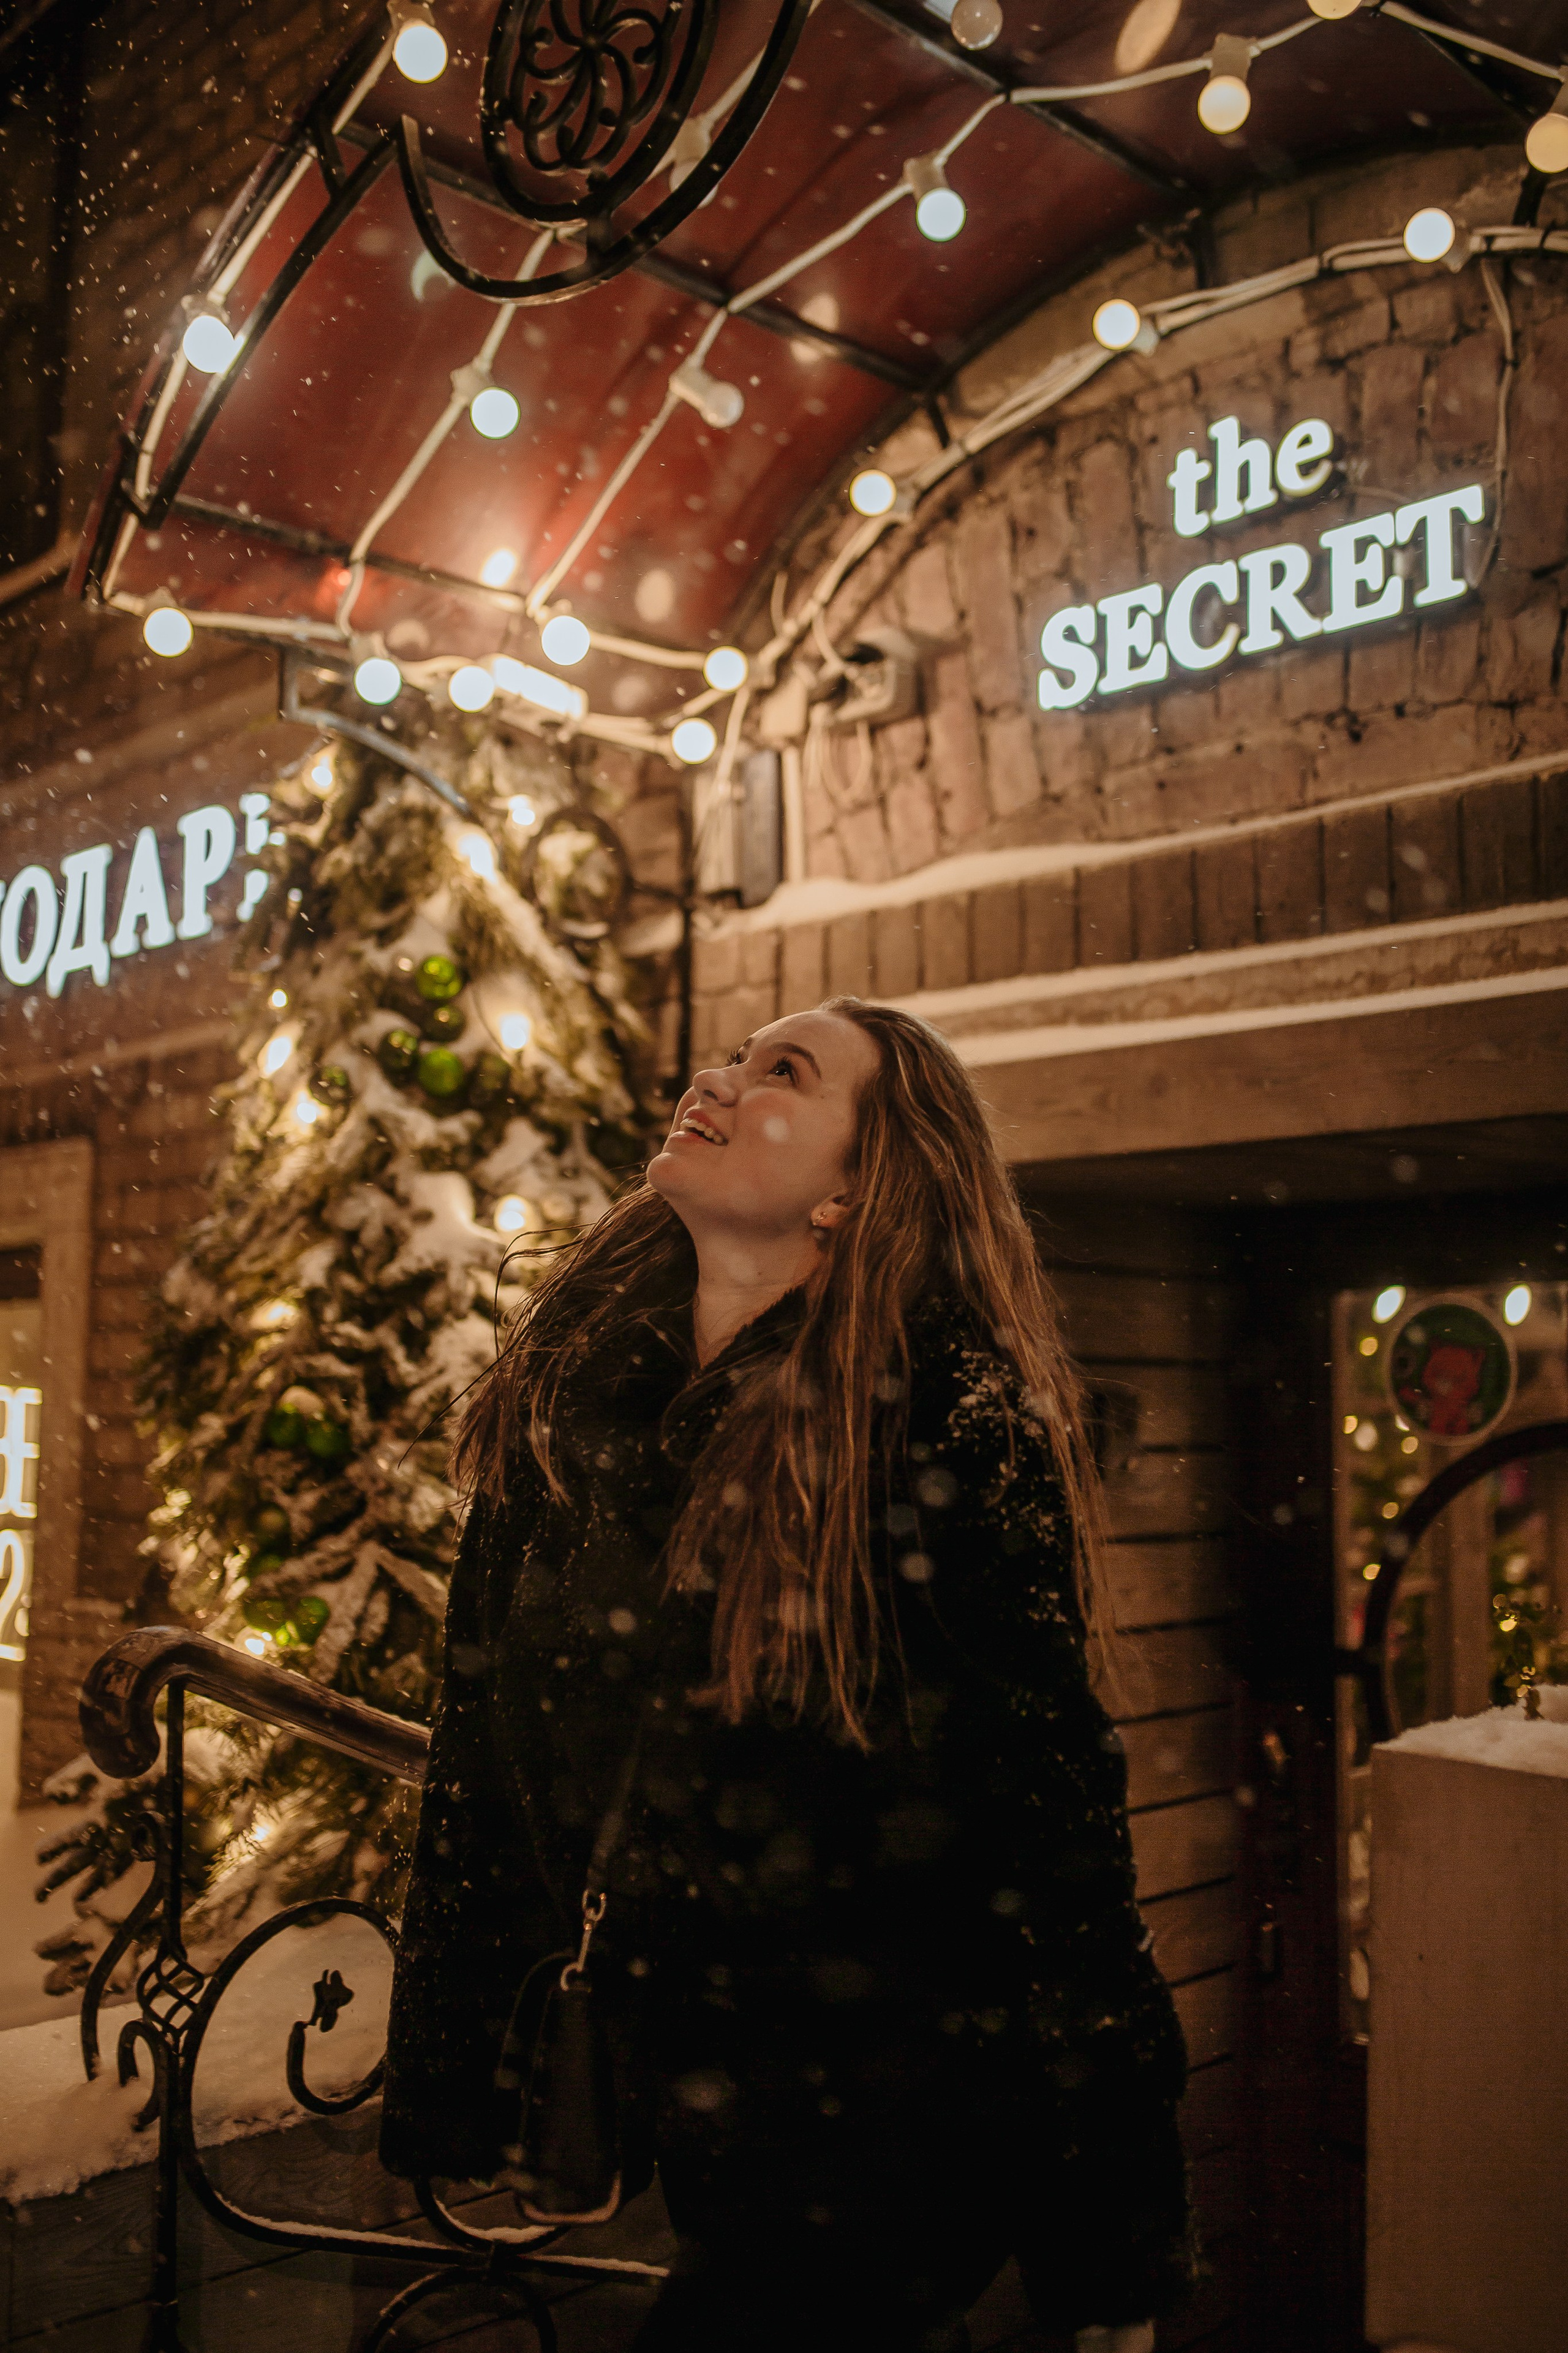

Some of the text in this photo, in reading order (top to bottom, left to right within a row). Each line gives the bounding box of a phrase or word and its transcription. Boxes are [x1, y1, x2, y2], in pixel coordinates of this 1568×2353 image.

[1167, 415, 1332, 537] the
[1038, 483, 1484, 711] SECRET
[0, 793, 285, 997] ОДАР
